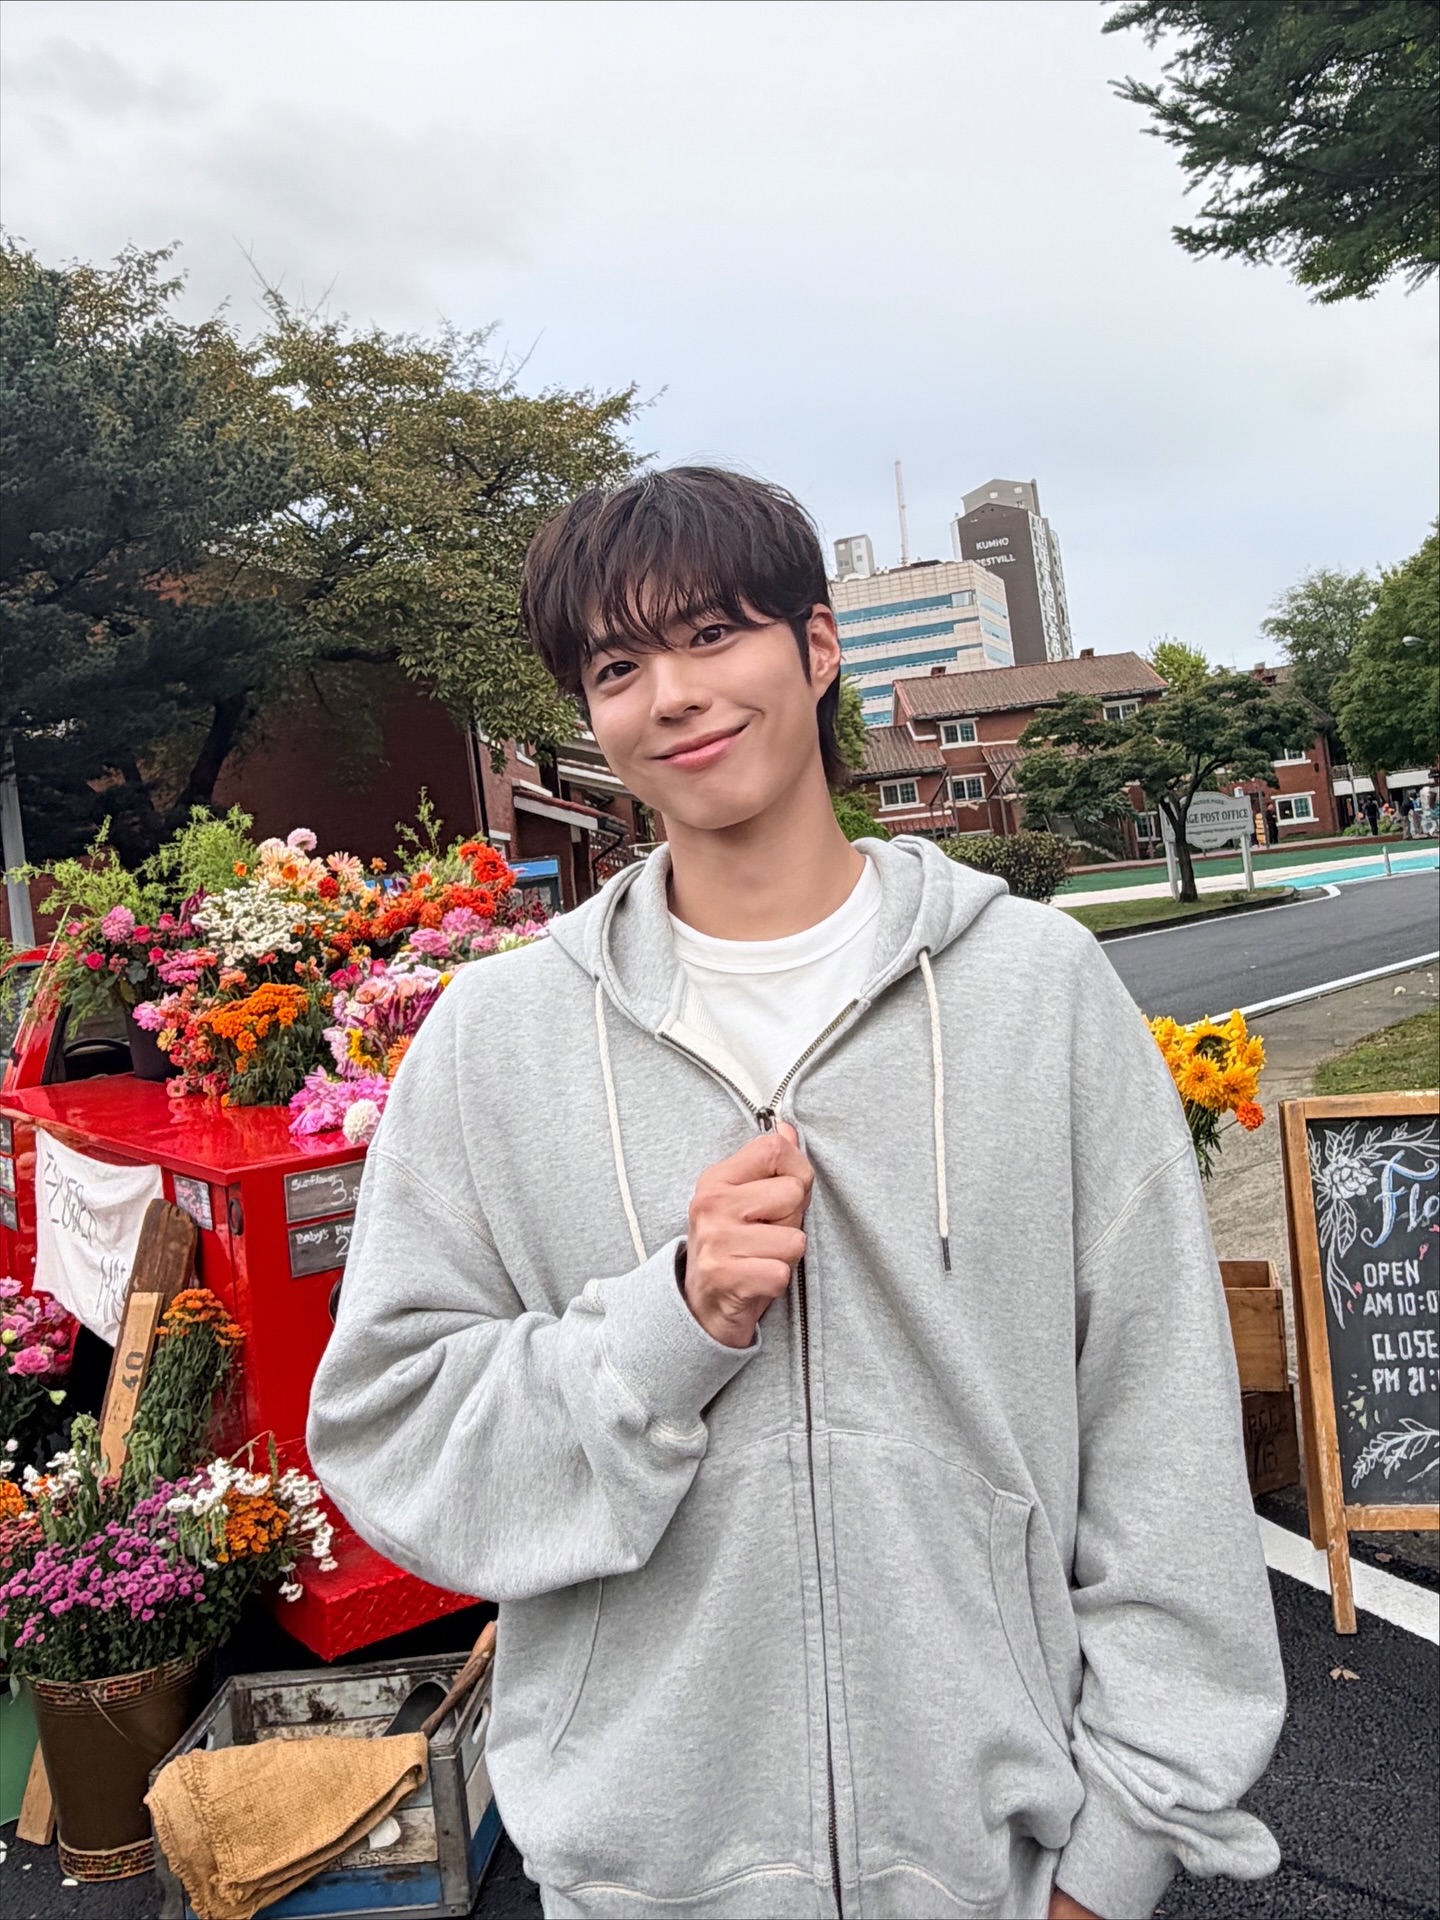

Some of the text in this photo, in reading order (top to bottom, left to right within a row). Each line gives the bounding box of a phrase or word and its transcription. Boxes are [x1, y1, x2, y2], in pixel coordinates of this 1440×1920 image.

[975, 537, 1009, 550] KUMHO
[1200, 811, 1220, 823] POST
[1222, 808, 1249, 820] OFFICE
[1363, 1258, 1420, 1288] OPEN
[1363, 1292, 1394, 1318] AM
[1371, 1329, 1439, 1361] CLOSE
[1371, 1367, 1401, 1395] PM
